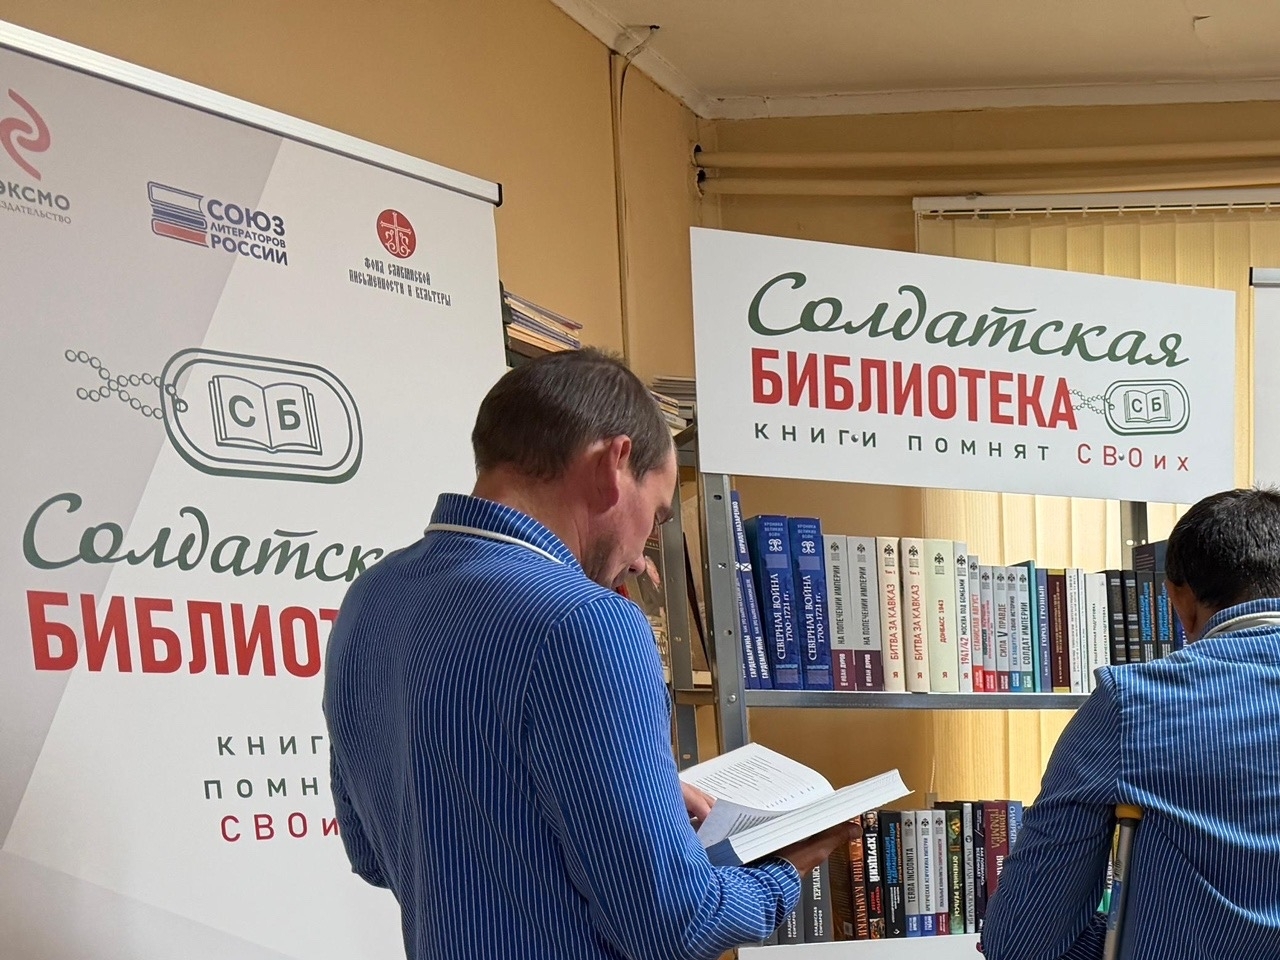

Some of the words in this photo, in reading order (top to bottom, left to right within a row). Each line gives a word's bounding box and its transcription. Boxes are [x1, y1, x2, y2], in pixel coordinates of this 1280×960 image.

[0, 200, 72, 224] ЗДАТЕЛЬСТВО
[207, 199, 285, 236] СОЮЗ
[210, 222, 286, 248] ЛИТЕРАТОРОВ
[210, 233, 288, 266] РОССИИ
[747, 271, 1190, 368] Солдатская
[751, 347, 1078, 430] БИБЛИОТЕКА
[229, 395, 256, 428] С
[276, 399, 301, 430] Б
[754, 423, 877, 448] КНИГИ
[908, 435, 1049, 461] ПОМНЯТ
[732, 501, 744, 531] НАЗАРЕНКО
[22, 492, 385, 582] Солдатск
[738, 532, 746, 553] КИРИЛЛ
[770, 573, 781, 608] ВОЙНА
[803, 575, 812, 610] ВОЙНА
[833, 565, 842, 595] ИМПЕРИИ
[859, 566, 868, 597] ИМПЕРИИ
[835, 597, 844, 634] ПОПЕЧЕНИИ
[861, 598, 869, 635] ПОПЕЧЕНИИ
[887, 584, 896, 618] КАВКАЗ
[911, 585, 921, 619] КАВКАЗ
[998, 604, 1006, 629] ПРАВДЕ
[26, 590, 340, 677] БИБЛИО
[783, 603, 793, 641] 1700-1721
[815, 604, 824, 643] 1700-1721
[888, 620, 897, 630] ЗА
[913, 620, 921, 631] ЗА
[939, 617, 947, 643] ДОНБАСС
[972, 618, 980, 651] СТАНИСЛАВ
[1020, 602, 1029, 635] ИМПЕРИИ
[773, 612, 786, 659] СЕВЕРНАЯ
[805, 613, 817, 660] СЕВЕРНАЯ
[837, 636, 845, 644] НА
[863, 636, 870, 645] НА
[889, 633, 899, 660] БИТВА
[913, 634, 923, 660] БИТВА
[960, 637, 969, 664] 1941/42
[999, 640, 1007, 657] СИЛА
[1022, 637, 1030, 664] СОЛДАТ
[745, 635, 756, 678] ГАРДЕМАРИНЫ
[756, 636, 769, 678] ГАРДЕМАРИНЫ
[217, 736, 323, 756] КНИГ
[204, 777, 319, 799] ПОМН
[221, 812, 340, 842] СВОи
[867, 838, 880, 882] ХРУЦКИЙ
[906, 848, 914, 881] INCOGNITA
[854, 886, 867, 936] КАМЧАТКИ
